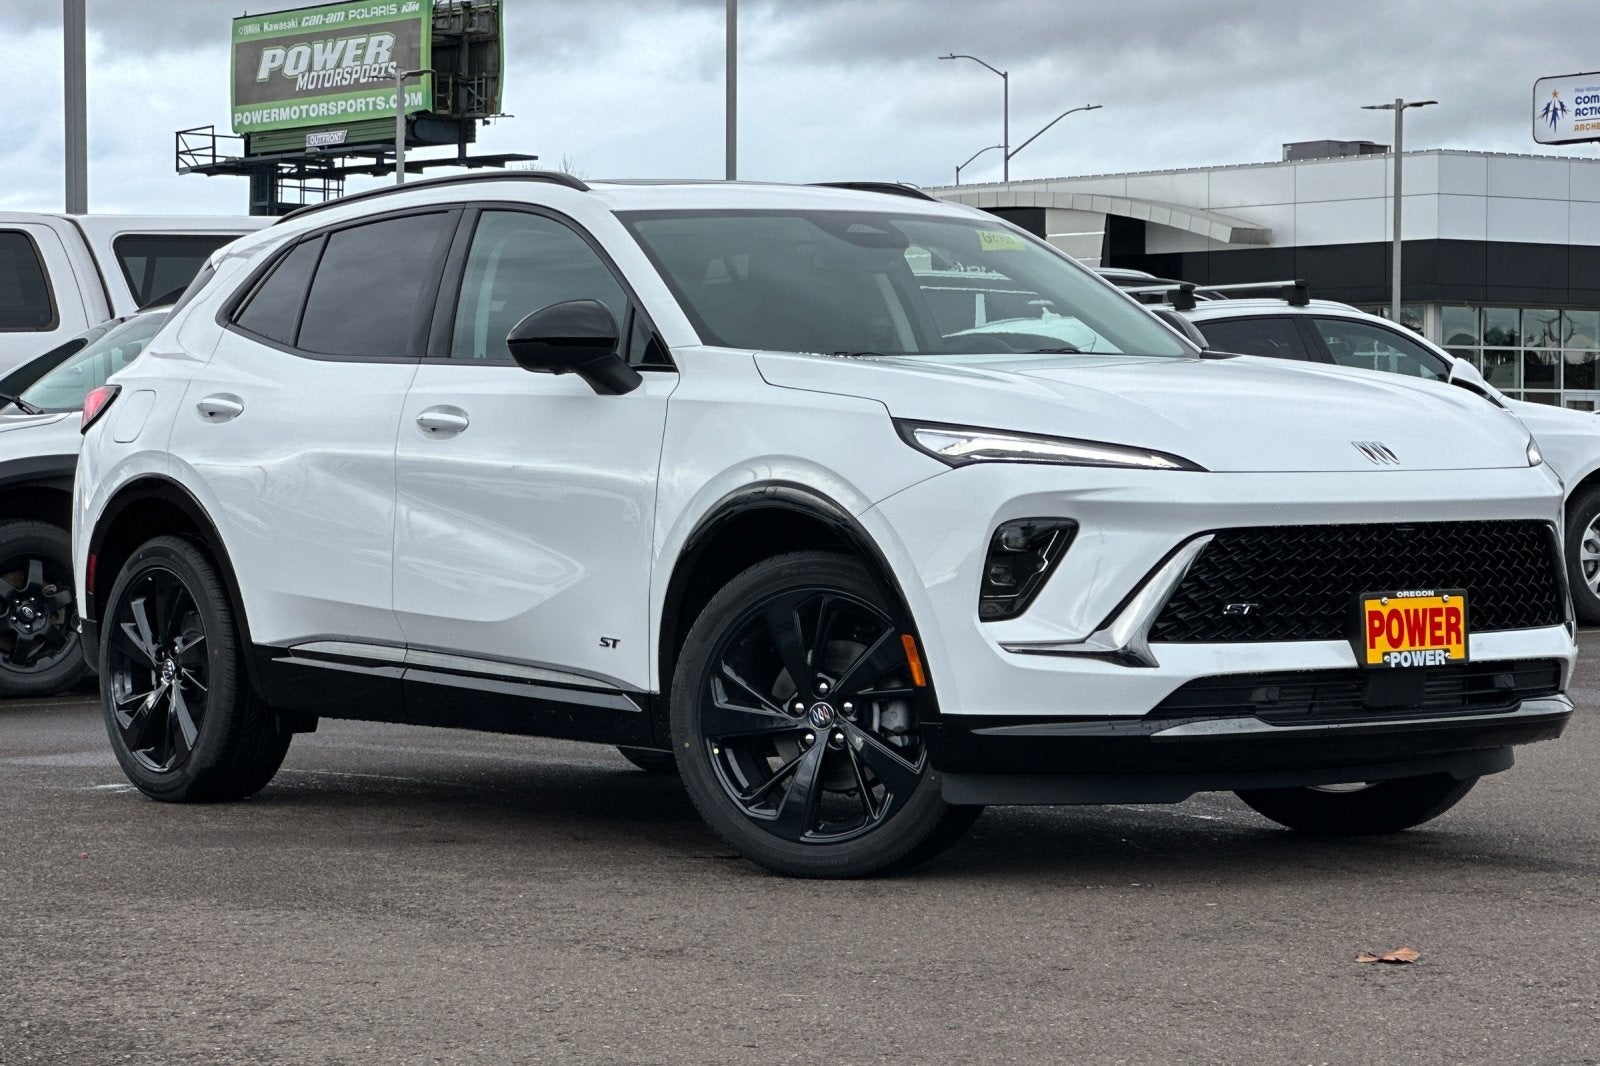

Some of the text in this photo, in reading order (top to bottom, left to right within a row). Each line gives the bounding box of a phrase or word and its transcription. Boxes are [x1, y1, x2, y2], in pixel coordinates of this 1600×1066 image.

[263, 18, 298, 33] Kawasaki
[301, 11, 345, 27] can-am
[348, 4, 397, 20] POLARIS
[401, 1, 420, 14] KTM
[257, 34, 393, 81] POWER
[295, 61, 397, 91] MOTORSPORTS
[309, 132, 343, 145] OUTFRONT
[1396, 590, 1435, 598] OREGON
[1367, 607, 1463, 650] POWER
[599, 636, 621, 649] ST
[1390, 650, 1446, 668] POWER
